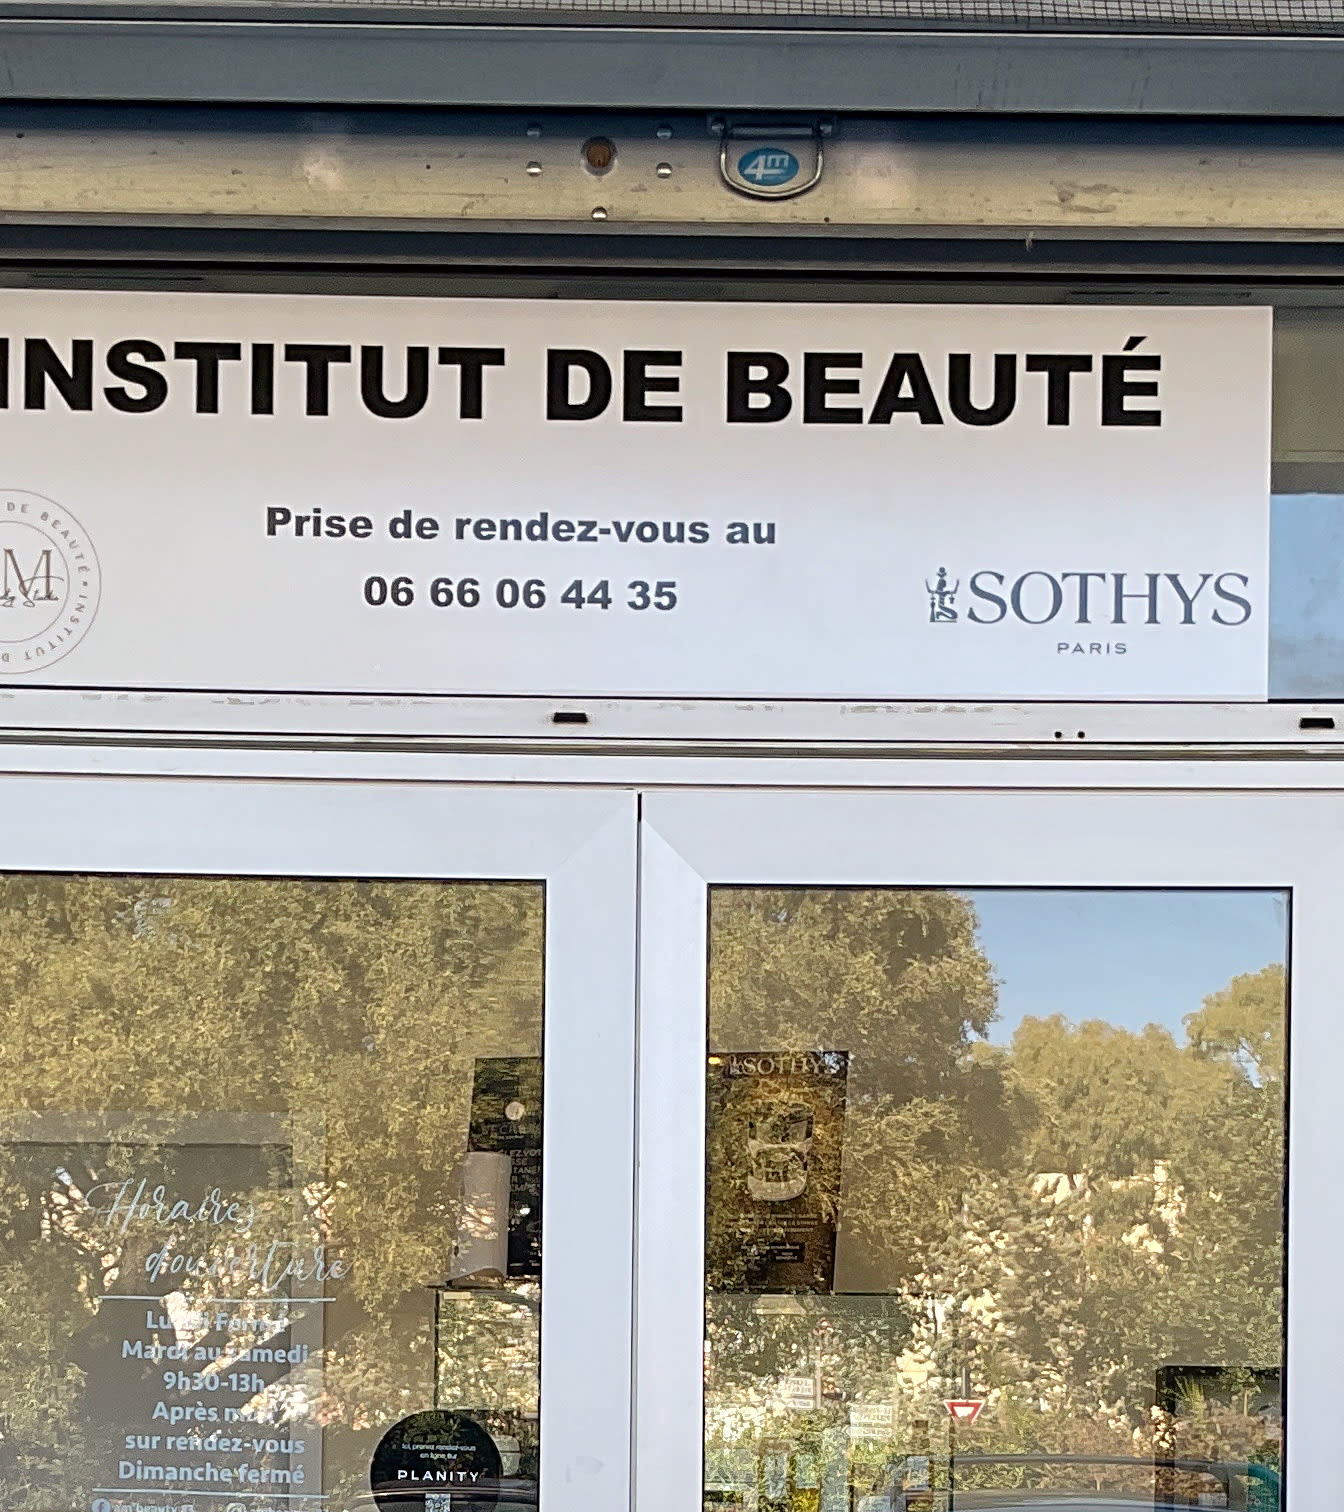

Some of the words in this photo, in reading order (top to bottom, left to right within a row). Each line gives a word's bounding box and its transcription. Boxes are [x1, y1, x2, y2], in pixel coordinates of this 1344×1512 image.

[547, 349, 682, 422] DE
[727, 336, 1161, 426] BEAUTÉ
[7, 502, 29, 513] DE
[41, 511, 90, 573] BEAUTÉ
[267, 507, 373, 538] Prise
[389, 510, 439, 539] de
[456, 512, 709, 543] rendez-vous
[727, 522, 775, 544] au
[365, 577, 414, 606] 06
[431, 578, 480, 607] 66
[496, 579, 545, 608] 06
[561, 580, 612, 609] 44
[628, 581, 677, 610] 35
[968, 571, 1251, 625] SOTHYS
[25, 595, 87, 660] INSTITUT
[1058, 643, 1126, 654] PARIS
[742, 1055, 836, 1075] SOTHY
[84, 1177, 256, 1235] Horaires
[146, 1310, 209, 1331] Lui
[121, 1340, 188, 1361] Mardi
[194, 1346, 221, 1361] au
[226, 1344, 308, 1364] amedi
[163, 1372, 265, 1393] 9h30-13h
[152, 1401, 218, 1424] Après
[125, 1434, 160, 1450] sur
[166, 1433, 305, 1454] rendez-vous
[118, 1460, 232, 1482] Dimanche
[238, 1463, 305, 1484] fermé
[398, 1470, 478, 1482] PLANITY
